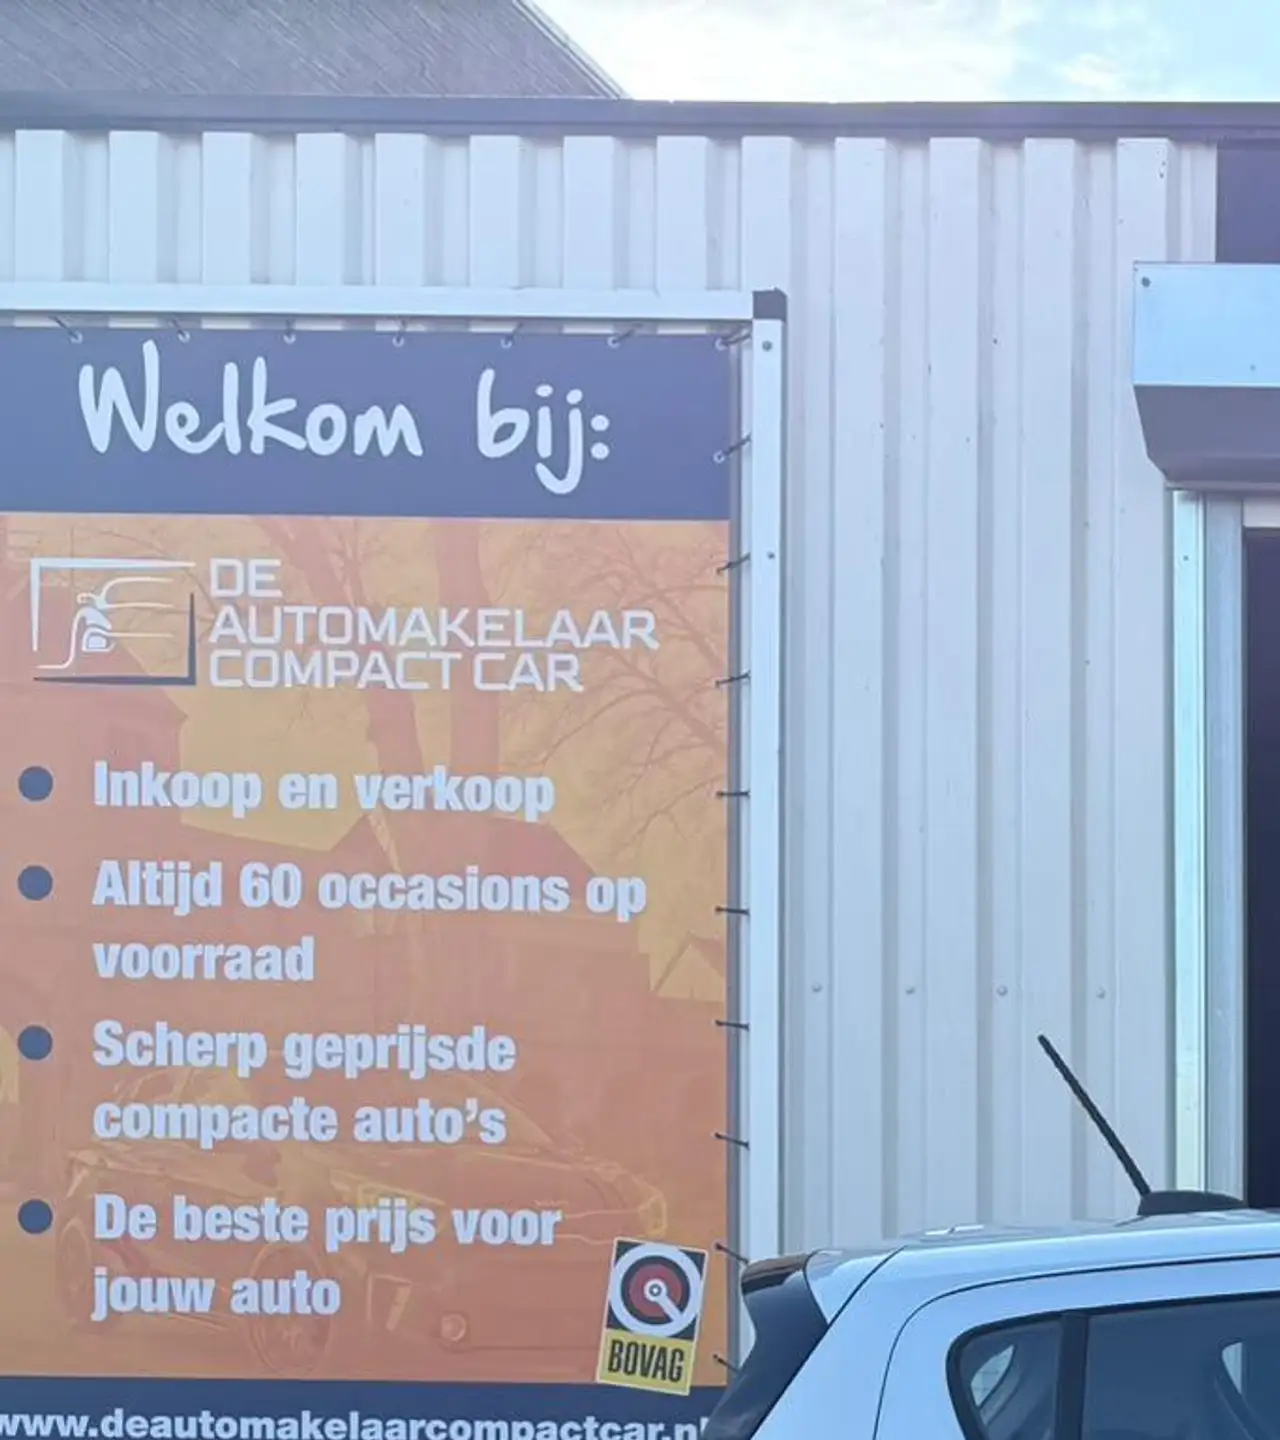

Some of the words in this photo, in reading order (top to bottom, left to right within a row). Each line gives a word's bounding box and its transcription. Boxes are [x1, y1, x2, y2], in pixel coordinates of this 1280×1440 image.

[79, 340, 423, 456] Welkom
[476, 369, 609, 494] bij:
[209, 558, 283, 598] DE
[208, 605, 660, 650] AUTOMAKELAAR
[209, 650, 462, 690] COMPACT
[473, 653, 584, 692] CAR
[94, 761, 262, 818] Inkoop
[278, 772, 338, 811] en
[355, 766, 556, 822] verkoop
[92, 860, 223, 916] Altijd
[239, 862, 302, 908] 60
[317, 866, 571, 912] occasions
[586, 874, 647, 921] op
[92, 936, 315, 981] voorraad
[92, 1020, 268, 1077] Scherp
[284, 1026, 517, 1079] geprijsde
[92, 1096, 338, 1149] compacte
[93, 1195, 157, 1240] De
[173, 1197, 310, 1243] beste
[325, 1199, 437, 1252] prijs
[452, 1208, 563, 1246] voor
[91, 1267, 216, 1321] jouw
[231, 1271, 342, 1315] auto
[607, 1338, 685, 1383] BOVAG
